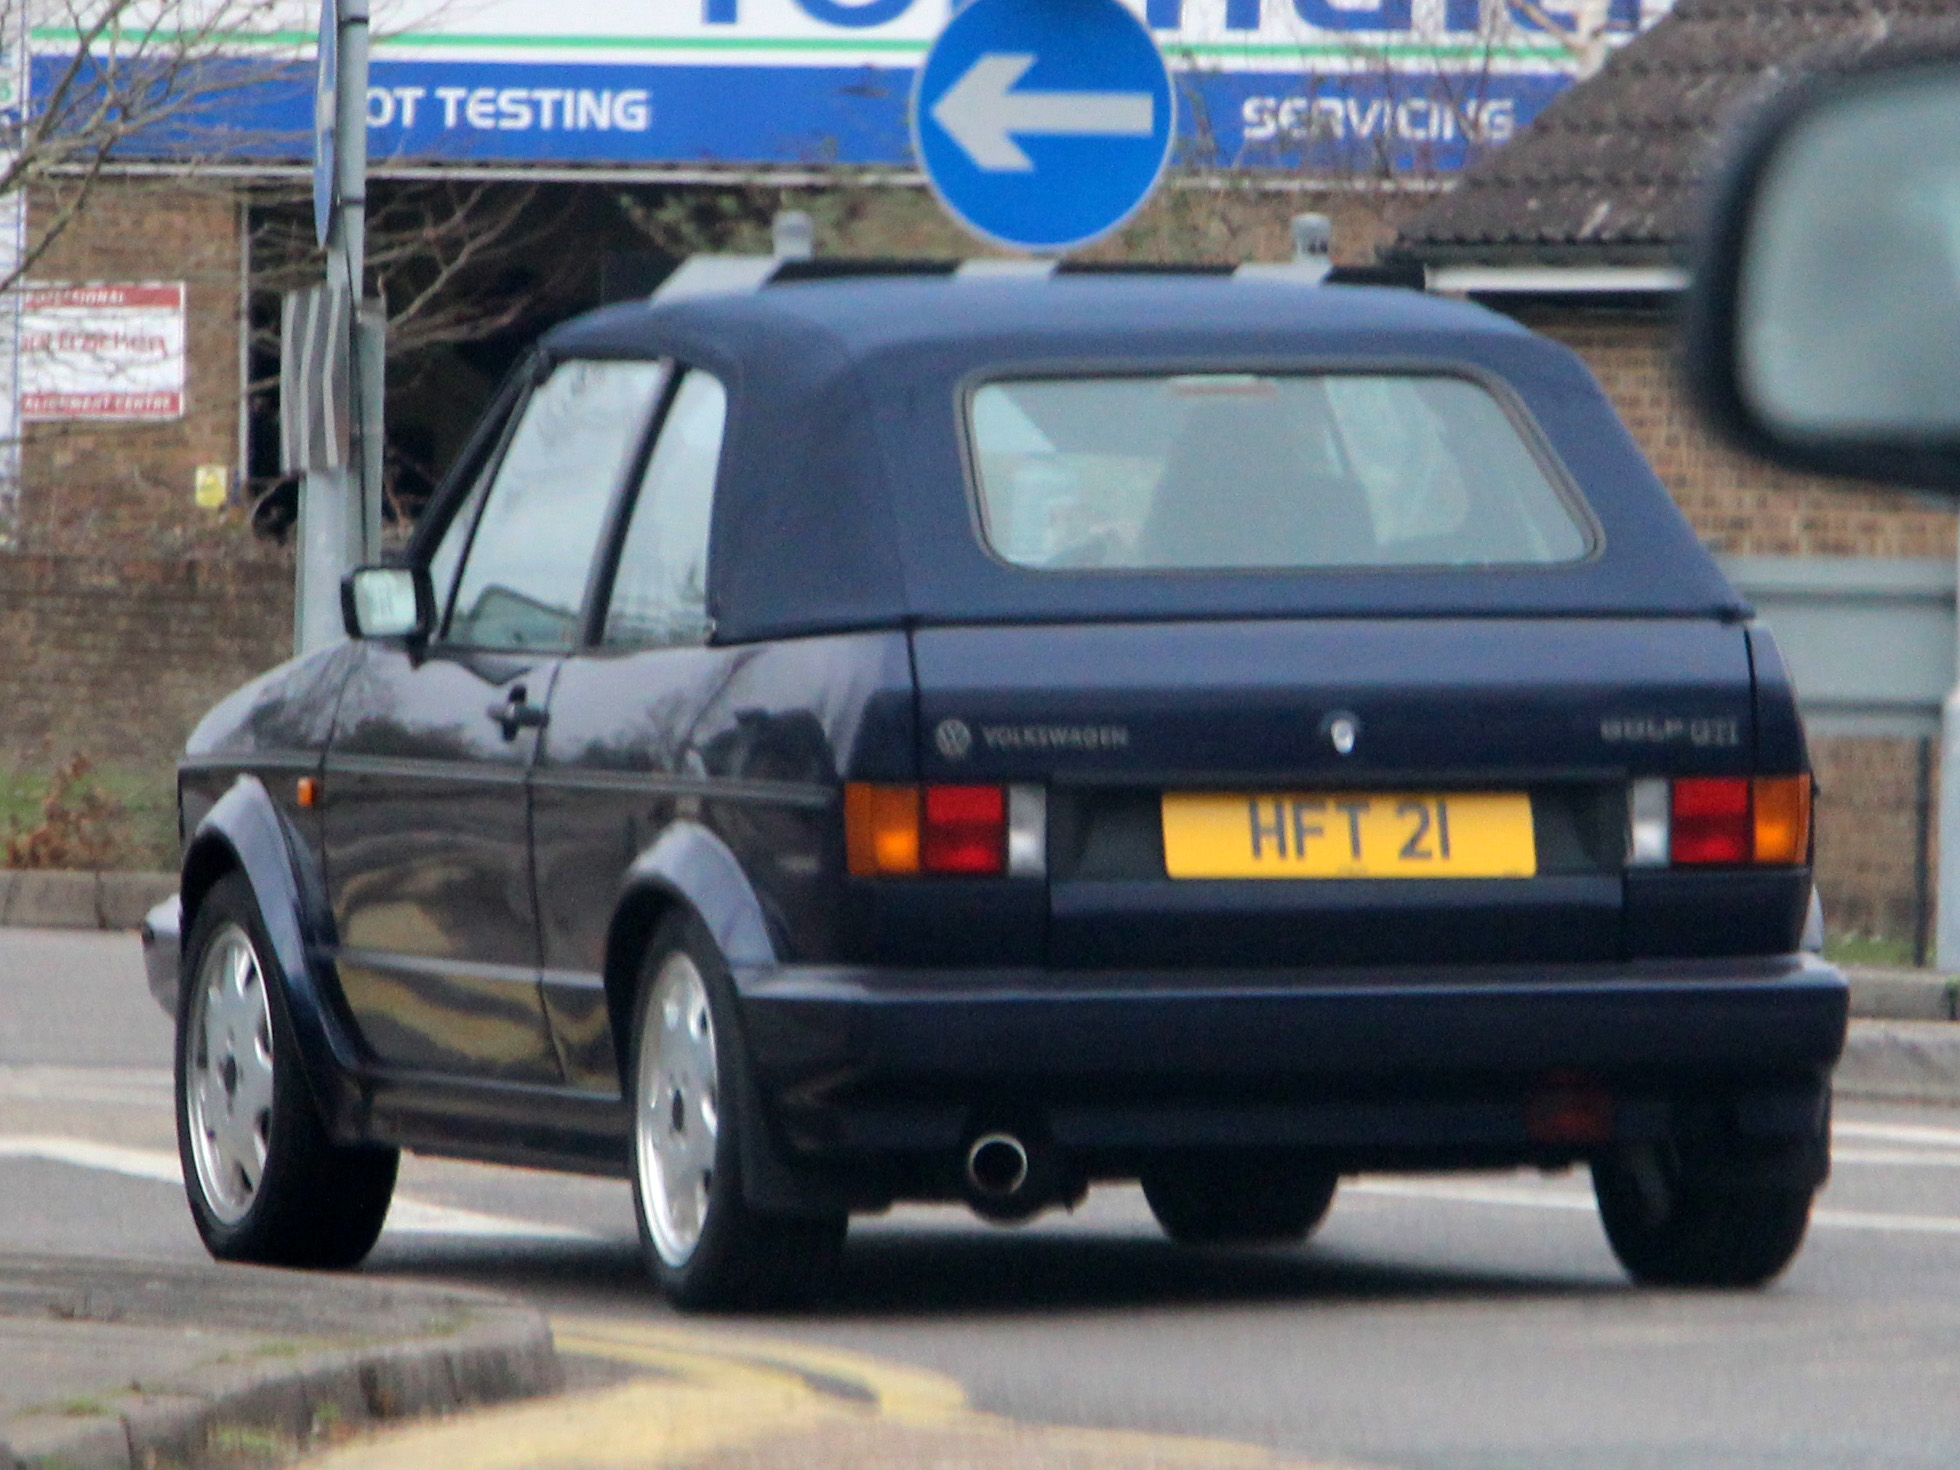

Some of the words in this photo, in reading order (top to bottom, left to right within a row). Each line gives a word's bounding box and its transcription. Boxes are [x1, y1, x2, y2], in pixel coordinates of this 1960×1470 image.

[366, 87, 426, 127] OT
[435, 88, 648, 131] TESTING
[1242, 96, 1514, 141] SERVICING
[1250, 799, 1370, 861] HFT
[1397, 799, 1450, 861] 21
